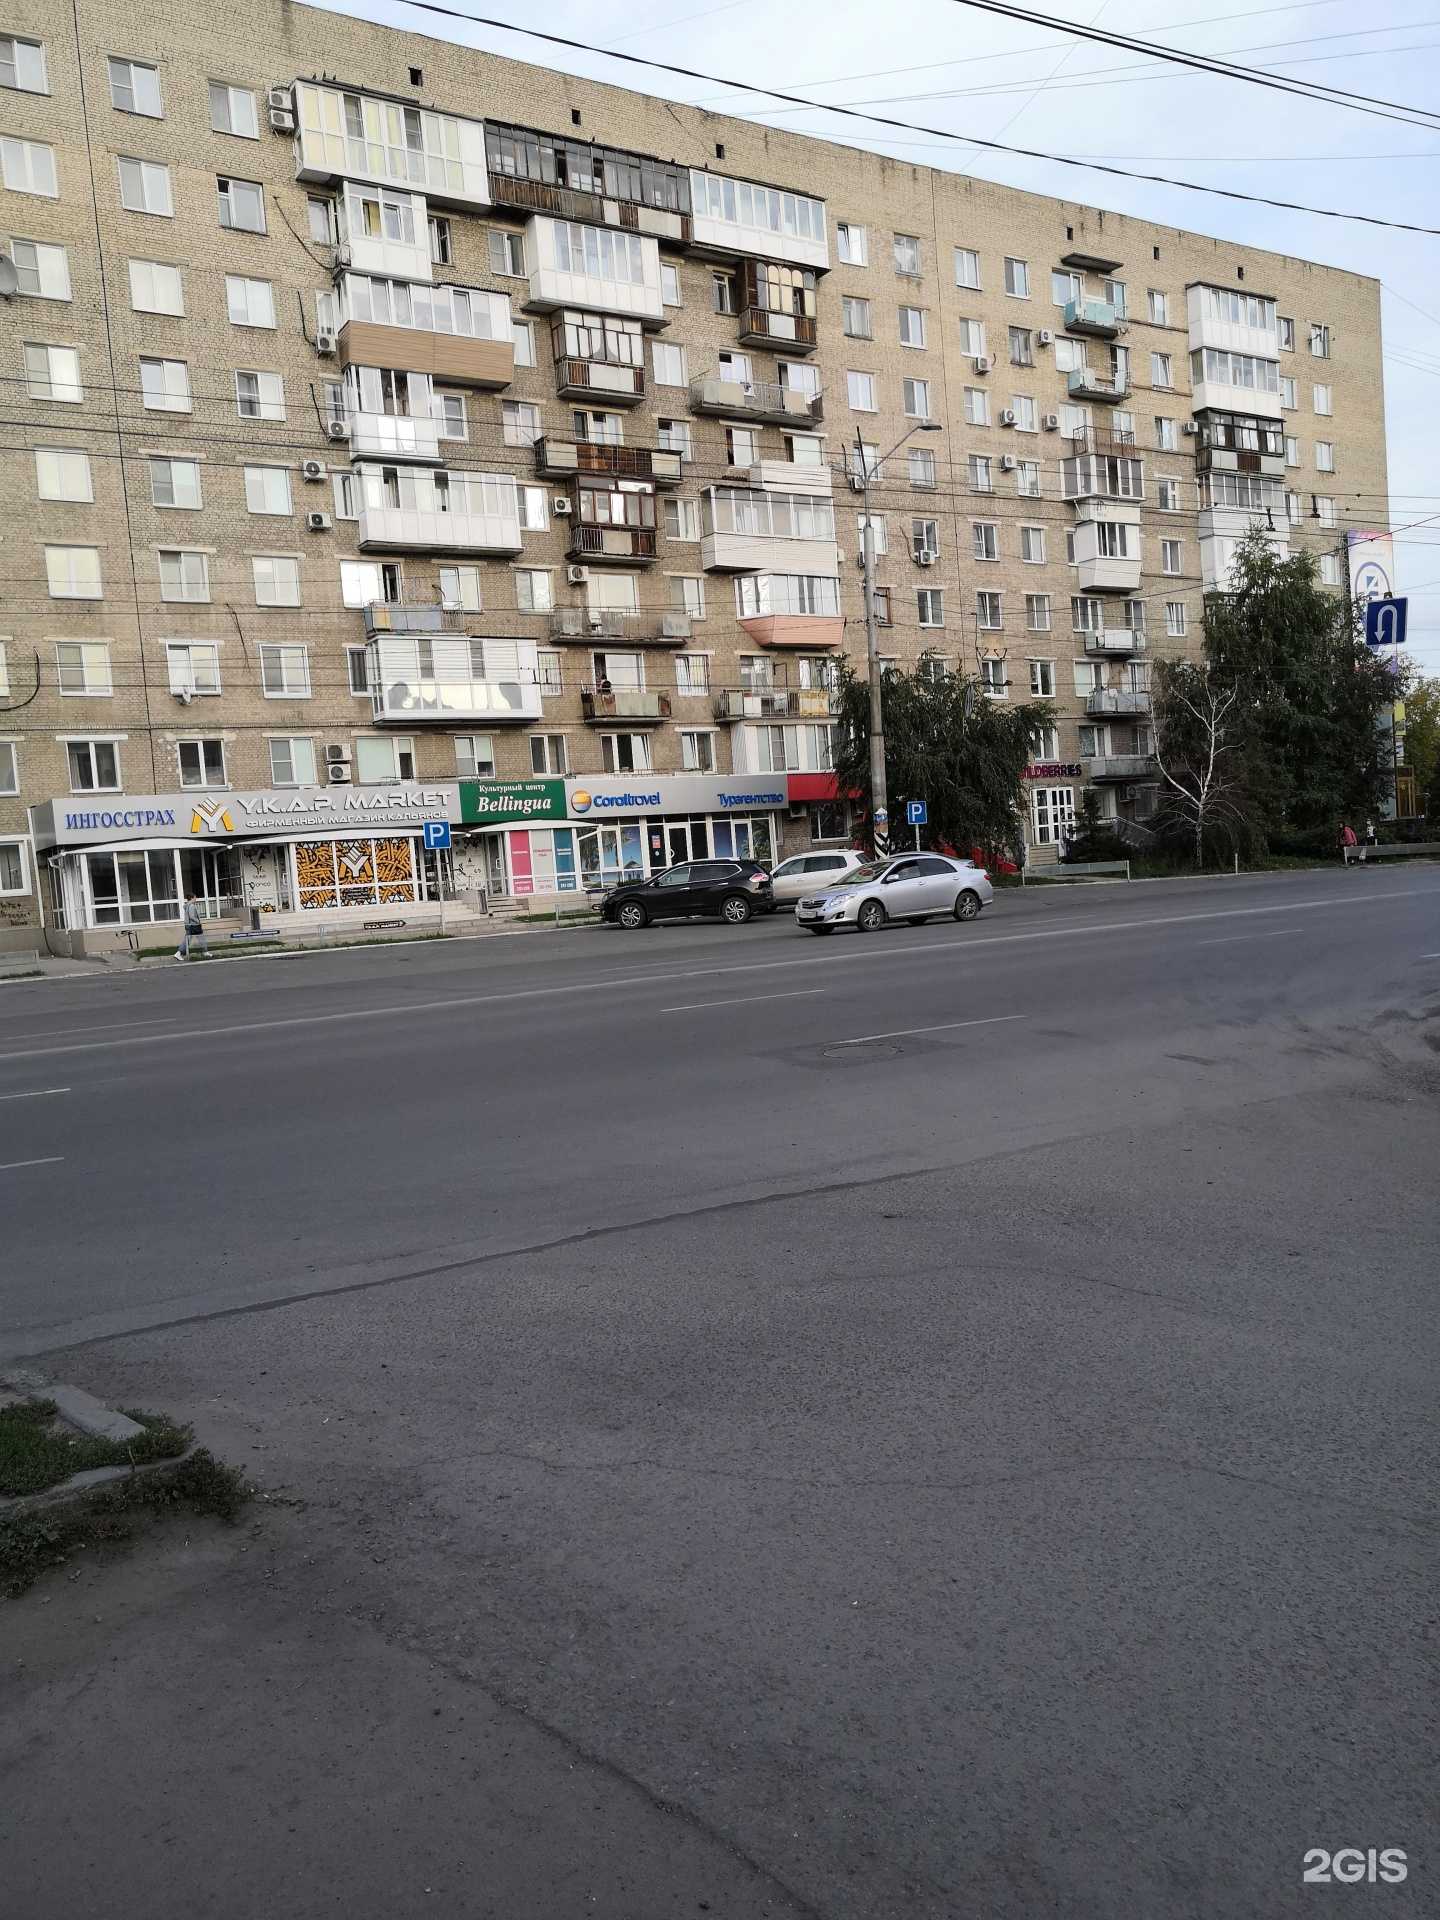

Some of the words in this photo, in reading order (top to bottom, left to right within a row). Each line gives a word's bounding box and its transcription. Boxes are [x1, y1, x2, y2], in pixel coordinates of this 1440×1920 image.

[479, 784, 522, 793] Культурный
[525, 784, 546, 792] центр
[344, 791, 450, 810] MARKET
[477, 796, 552, 814] Bellingua
[717, 793, 784, 807] Турагентство
[66, 809, 175, 830] ИНГОССТРАХ
[246, 816, 325, 827] ФИРМЕННЫЙ
[328, 813, 386, 824] МАГАЗИН
[388, 810, 448, 821] КАЛЬЯНОВ
[911, 803, 923, 822] P
[429, 823, 445, 846] P
